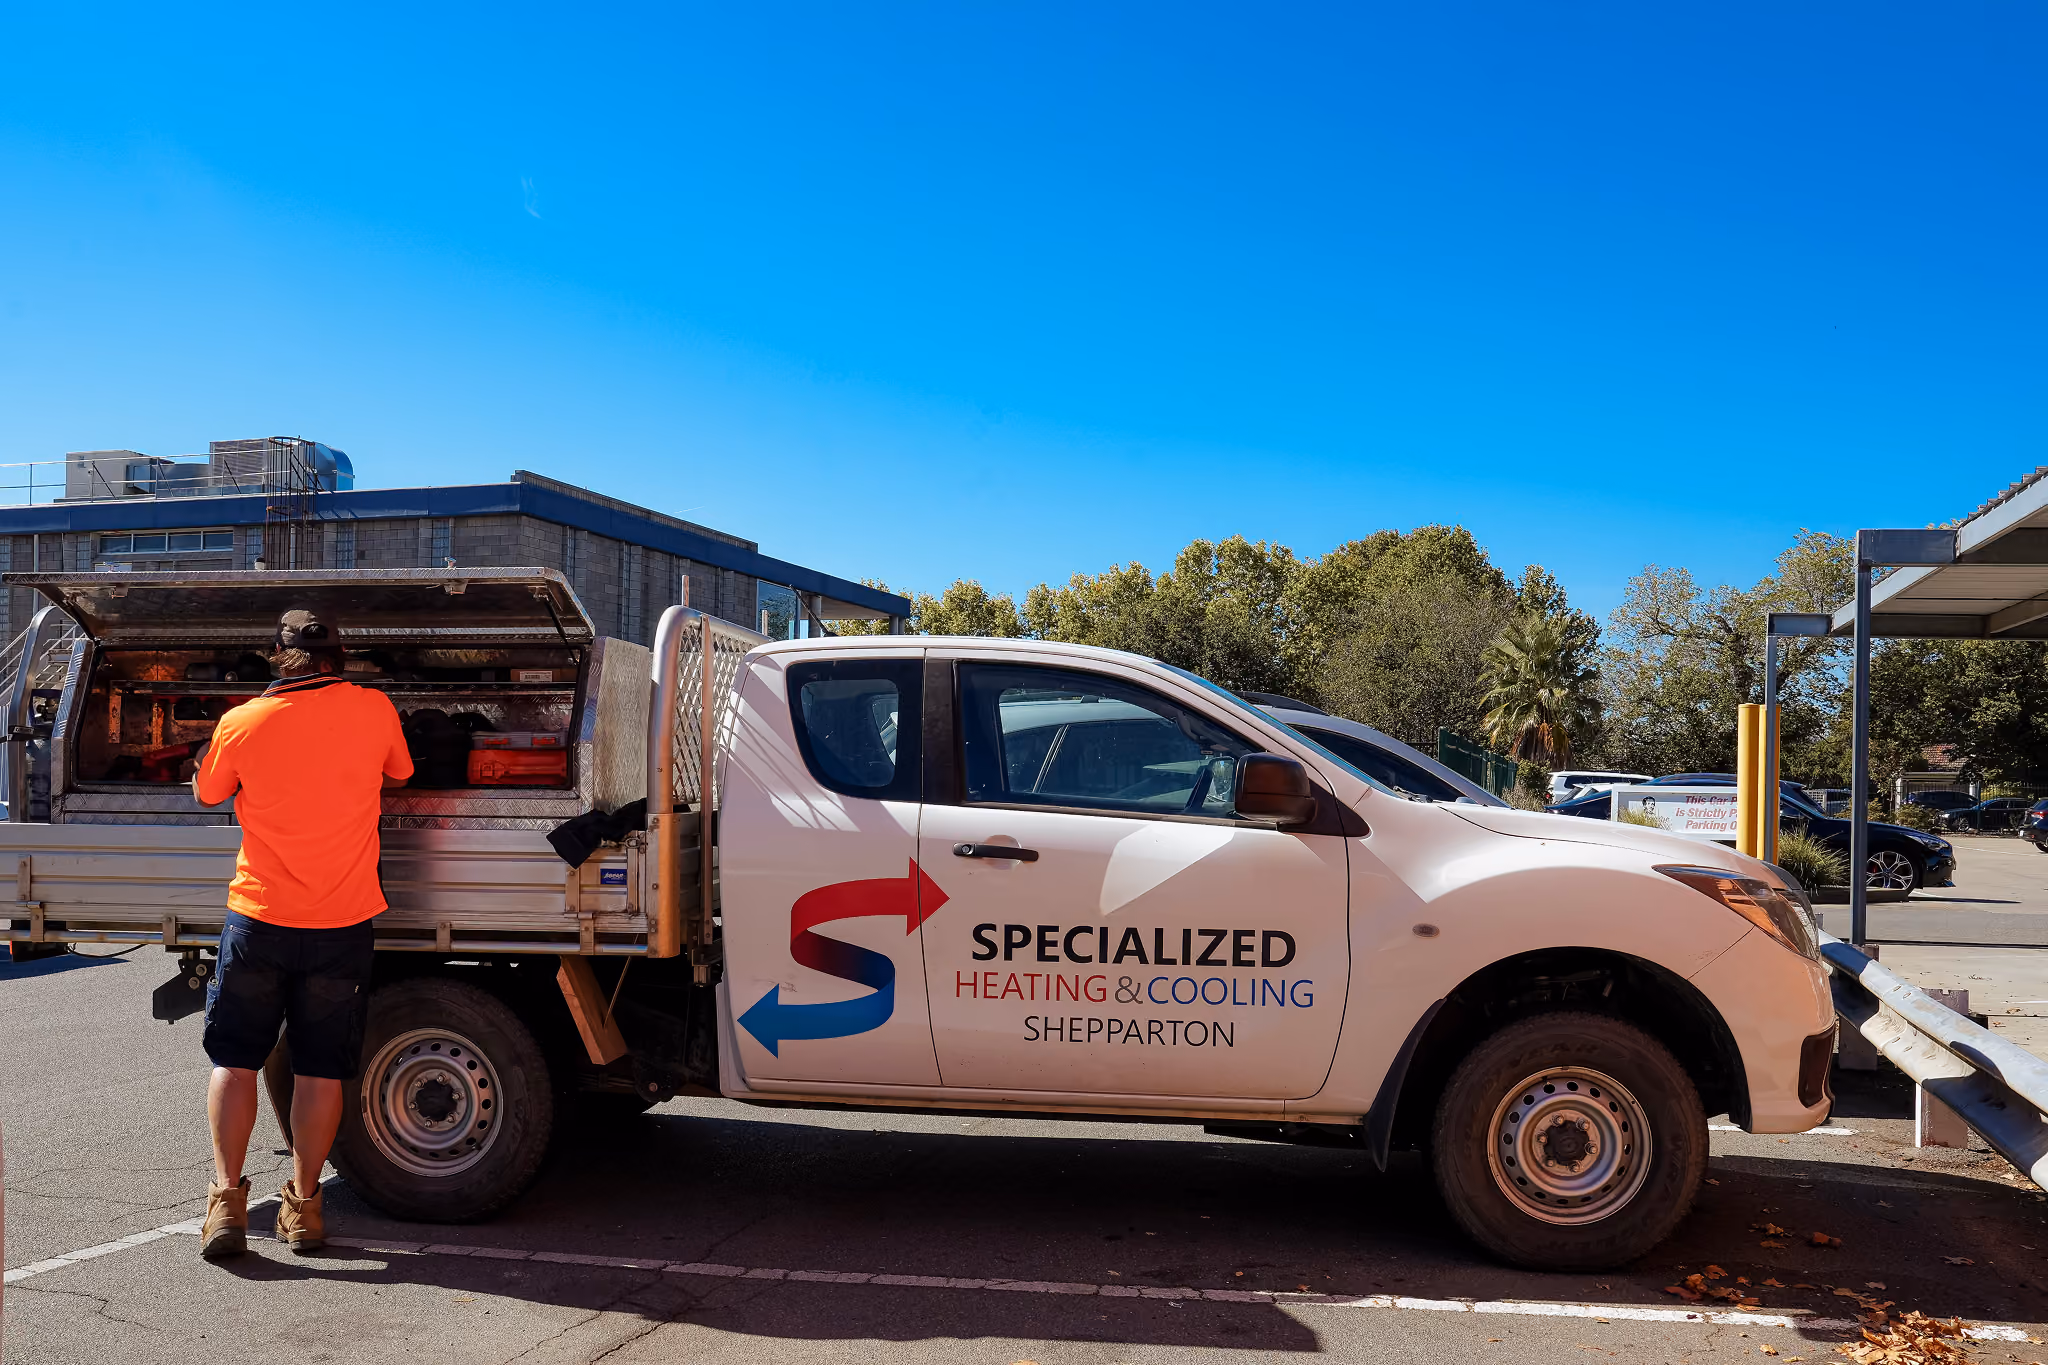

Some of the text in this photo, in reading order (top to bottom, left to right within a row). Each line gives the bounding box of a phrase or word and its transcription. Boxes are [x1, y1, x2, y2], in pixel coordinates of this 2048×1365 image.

[1685, 795, 1707, 805] This
[1709, 795, 1729, 805] Car
[1687, 807, 1727, 819] Strictly
[1685, 820, 1727, 832] Parking
[972, 922, 1296, 968] SPECIALIZED
[1023, 1015, 1235, 1047] SHEPPARTON
